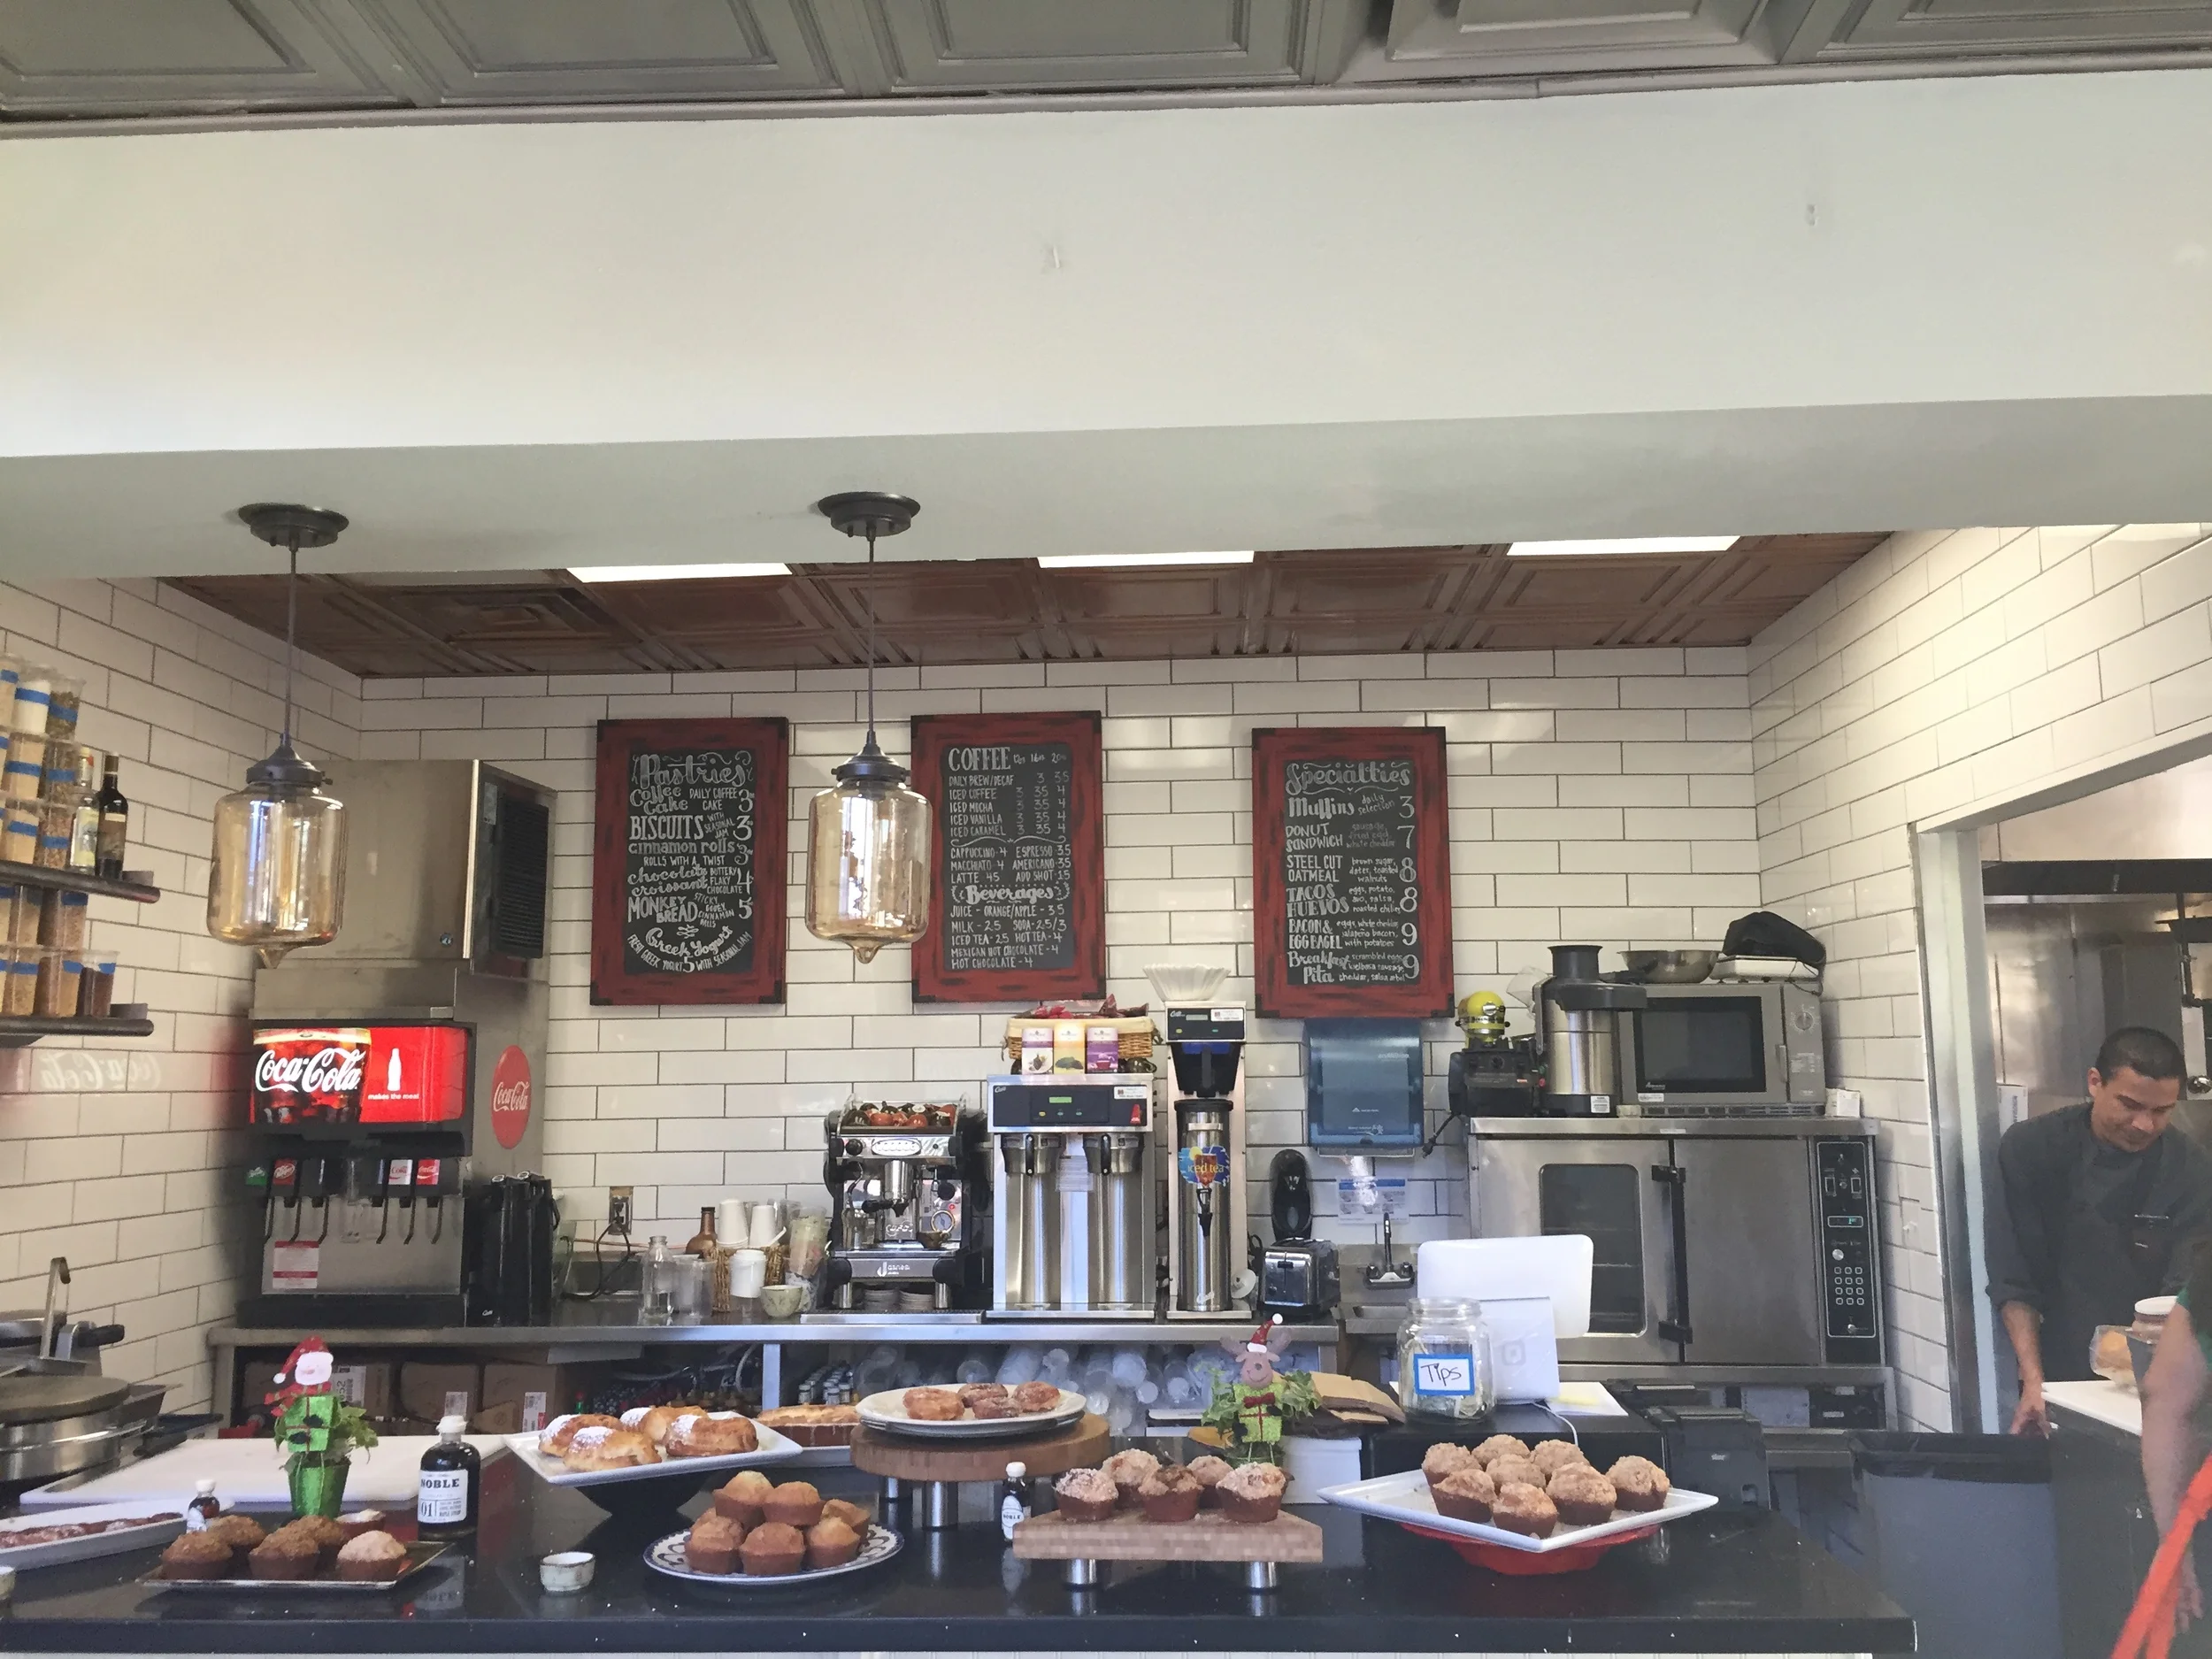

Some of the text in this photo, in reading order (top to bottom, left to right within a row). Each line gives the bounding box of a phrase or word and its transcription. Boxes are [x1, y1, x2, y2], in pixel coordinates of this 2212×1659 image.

[949, 747, 1010, 771] COFFEE
[641, 755, 746, 789] Pastries
[1286, 761, 1410, 795] Specialties
[949, 776, 967, 787] DAILY
[630, 785, 681, 807] Coffee
[690, 788, 710, 799] DAILY
[713, 787, 737, 799] COFFEE
[949, 789, 966, 800] ICED
[969, 787, 997, 800] COFFEE
[644, 796, 687, 815] Cake
[703, 800, 722, 810] CAKE
[950, 802, 966, 813] ICED
[969, 802, 993, 813] MOCHA
[1288, 797, 1355, 819] Muffins
[1399, 795, 1415, 818] 3
[707, 812, 724, 822] WITH
[950, 815, 968, 825] ICED
[971, 814, 1002, 825] VANILLA
[629, 815, 703, 840] BISCUITS
[704, 818, 735, 833] SEASONAL
[951, 826, 968, 838] ICED
[971, 826, 1006, 837] CARAMEL
[715, 828, 729, 839] JAM
[1286, 823, 1415, 849] DONUT 7
[628, 842, 697, 854] cinnamon
[701, 839, 735, 854] rolls
[1286, 834, 1343, 852] SANDWICH
[1016, 846, 1052, 857] ESPRESSO
[644, 856, 666, 866] ROLLS
[670, 856, 688, 865] WITH
[703, 856, 725, 865] TWIST
[1012, 859, 1055, 870] AMERICANO
[1286, 855, 1321, 869] STEEL
[1324, 856, 1343, 869] CUT
[1400, 857, 1417, 882] 8
[627, 864, 707, 885] chocolate
[710, 867, 737, 876] BUTTERY
[951, 872, 979, 883] LATTE
[1016, 870, 1053, 882] ADD SHOT
[1288, 870, 1339, 882] OATMEAL
[632, 877, 708, 897] croissant
[710, 876, 731, 885] FLAKY
[707, 886, 742, 895] CHOCOLATE
[965, 885, 1054, 904] Beverages
[1286, 884, 1335, 902] TACOS
[1400, 887, 1417, 912] 8
[695, 893, 718, 905] STICKY
[628, 893, 687, 922] MONKEY
[657, 902, 698, 923] BREAD
[698, 909, 734, 920] CINNAMON
[950, 905, 972, 918] JUICE
[1286, 898, 1349, 918] HUEVOS
[951, 921, 973, 933] MILK
[1288, 919, 1322, 933] BACON
[1402, 923, 1417, 946] 9
[646, 926, 733, 956] Greek Yogurt
[952, 934, 989, 946] ICED TEA
[1015, 932, 1033, 943] HOT
[1033, 932, 1047, 941] TEA
[1289, 934, 1309, 949] EGG
[1310, 935, 1342, 949] BAGEL
[627, 934, 644, 954] FRESH
[641, 949, 661, 968] GREEK
[951, 947, 986, 957] MEXICAN
[952, 958, 969, 970] HOT
[972, 957, 1016, 969] CHOCOLATE
[1287, 950, 1351, 970] Breakfast
[1402, 954, 1419, 979] 9
[1303, 964, 1334, 984] Pita
[255, 1048, 366, 1093] Coca-Cola
[1420, 1363, 1462, 1386] Tips
[420, 1478, 459, 1488] NOBLE
[420, 1502, 432, 1517] 01
